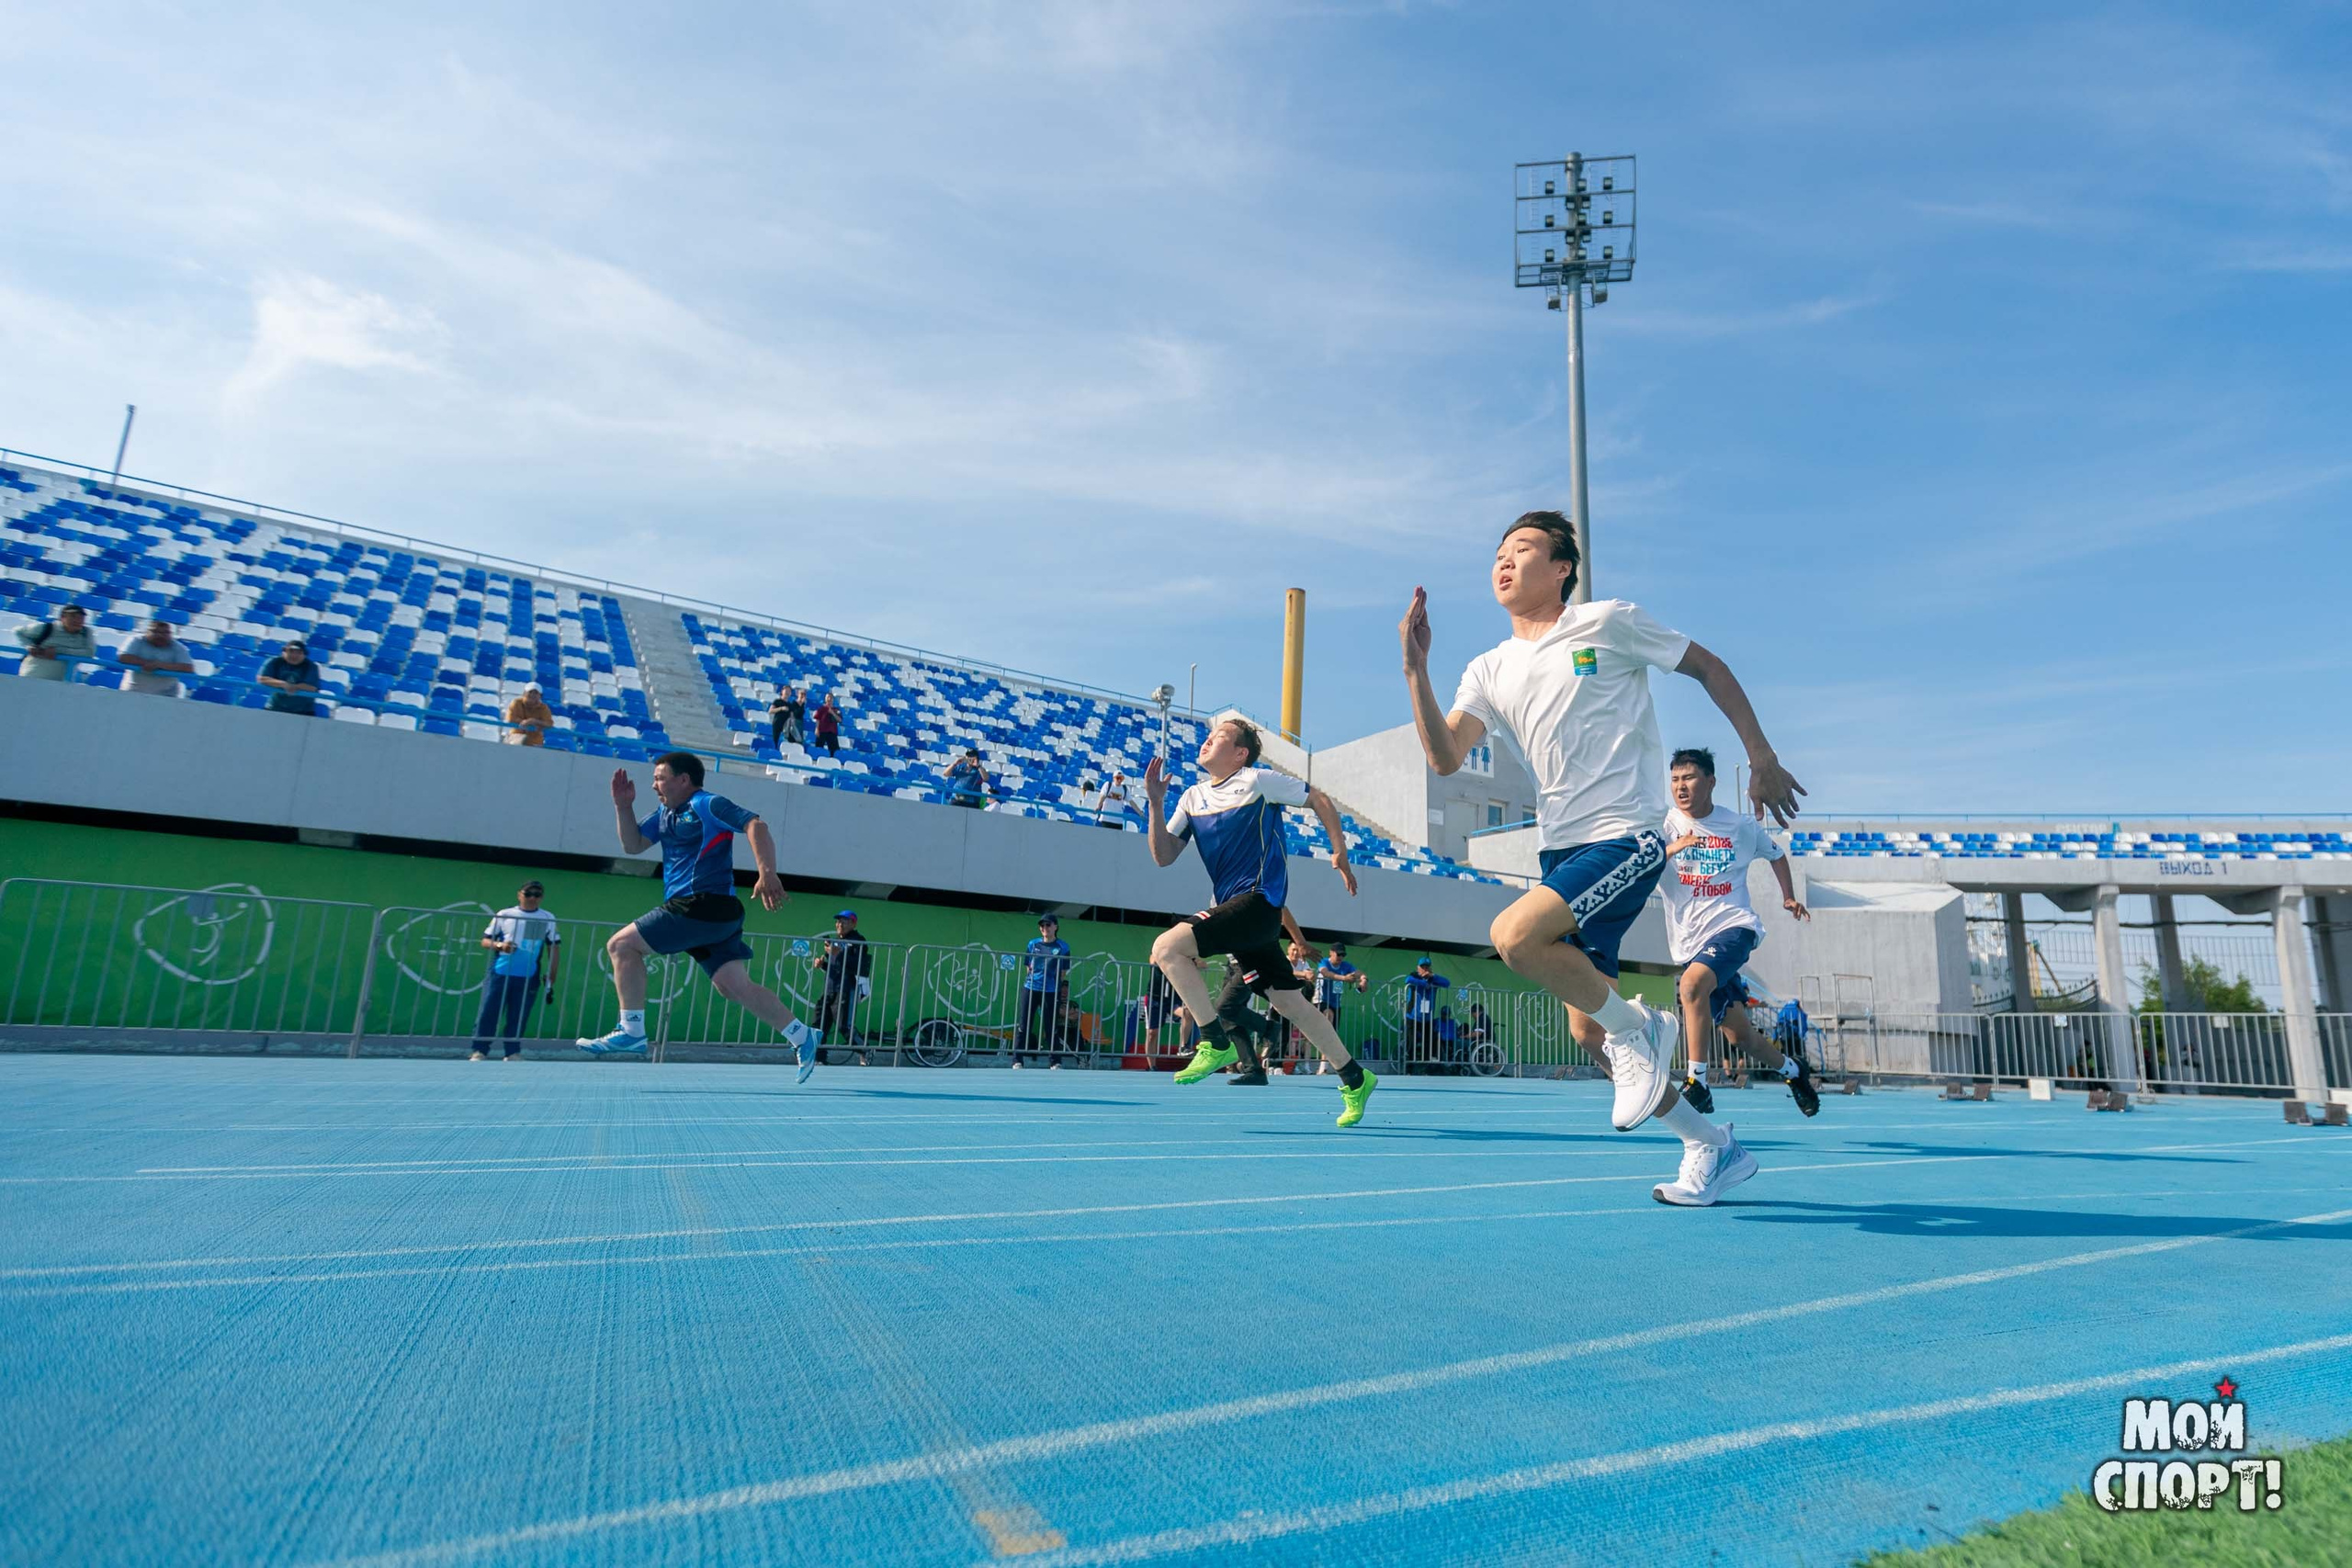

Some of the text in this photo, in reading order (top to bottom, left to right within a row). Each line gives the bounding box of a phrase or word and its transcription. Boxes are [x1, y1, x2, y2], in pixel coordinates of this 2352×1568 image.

[1708, 836, 1733, 848] 2025
[2159, 862, 2228, 875] ВЫХОД 1
[1701, 882, 1732, 897] ТОБОЙ
